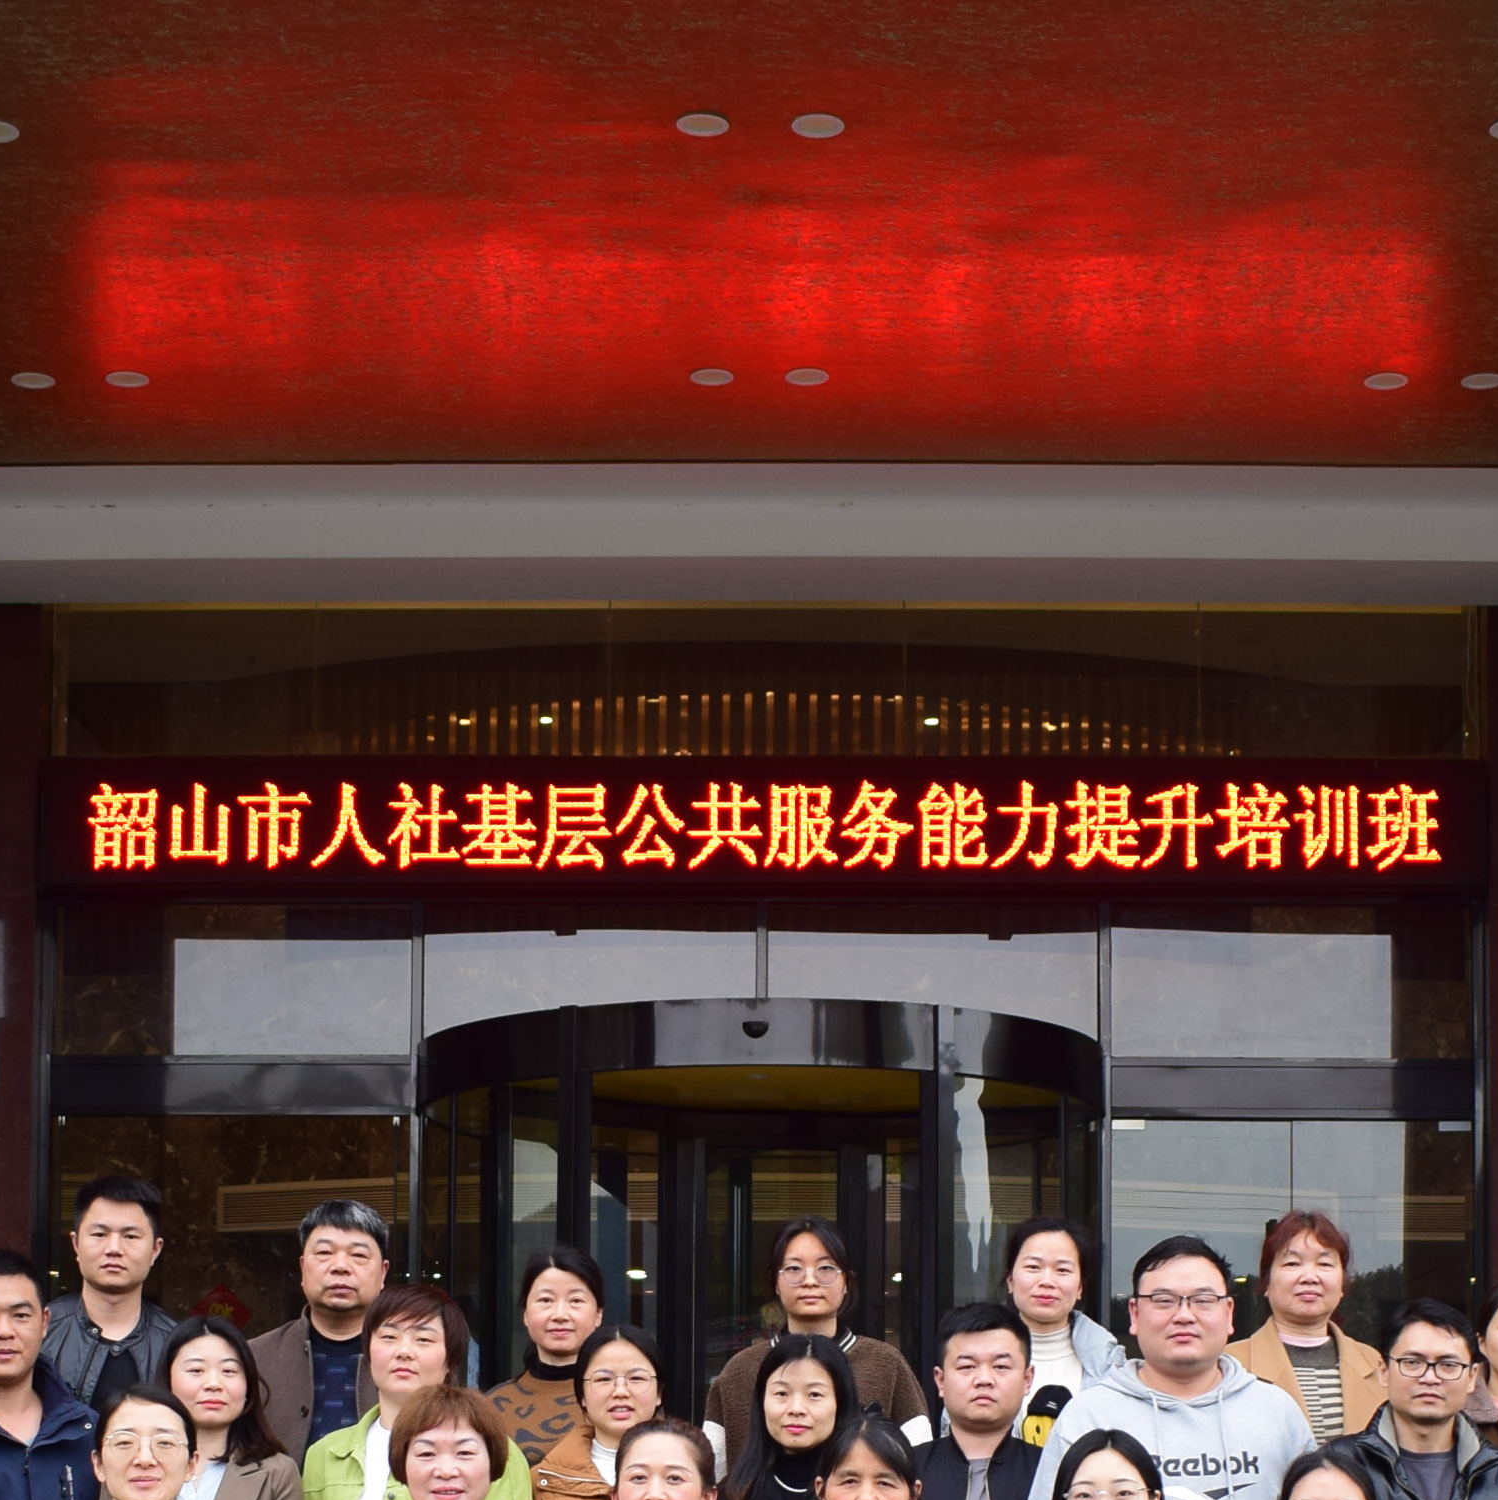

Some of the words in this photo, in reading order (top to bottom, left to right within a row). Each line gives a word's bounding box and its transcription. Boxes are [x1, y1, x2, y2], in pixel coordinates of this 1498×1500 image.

[88, 780, 1442, 871] 韶山市人社基层公共服务能力提升培训班
